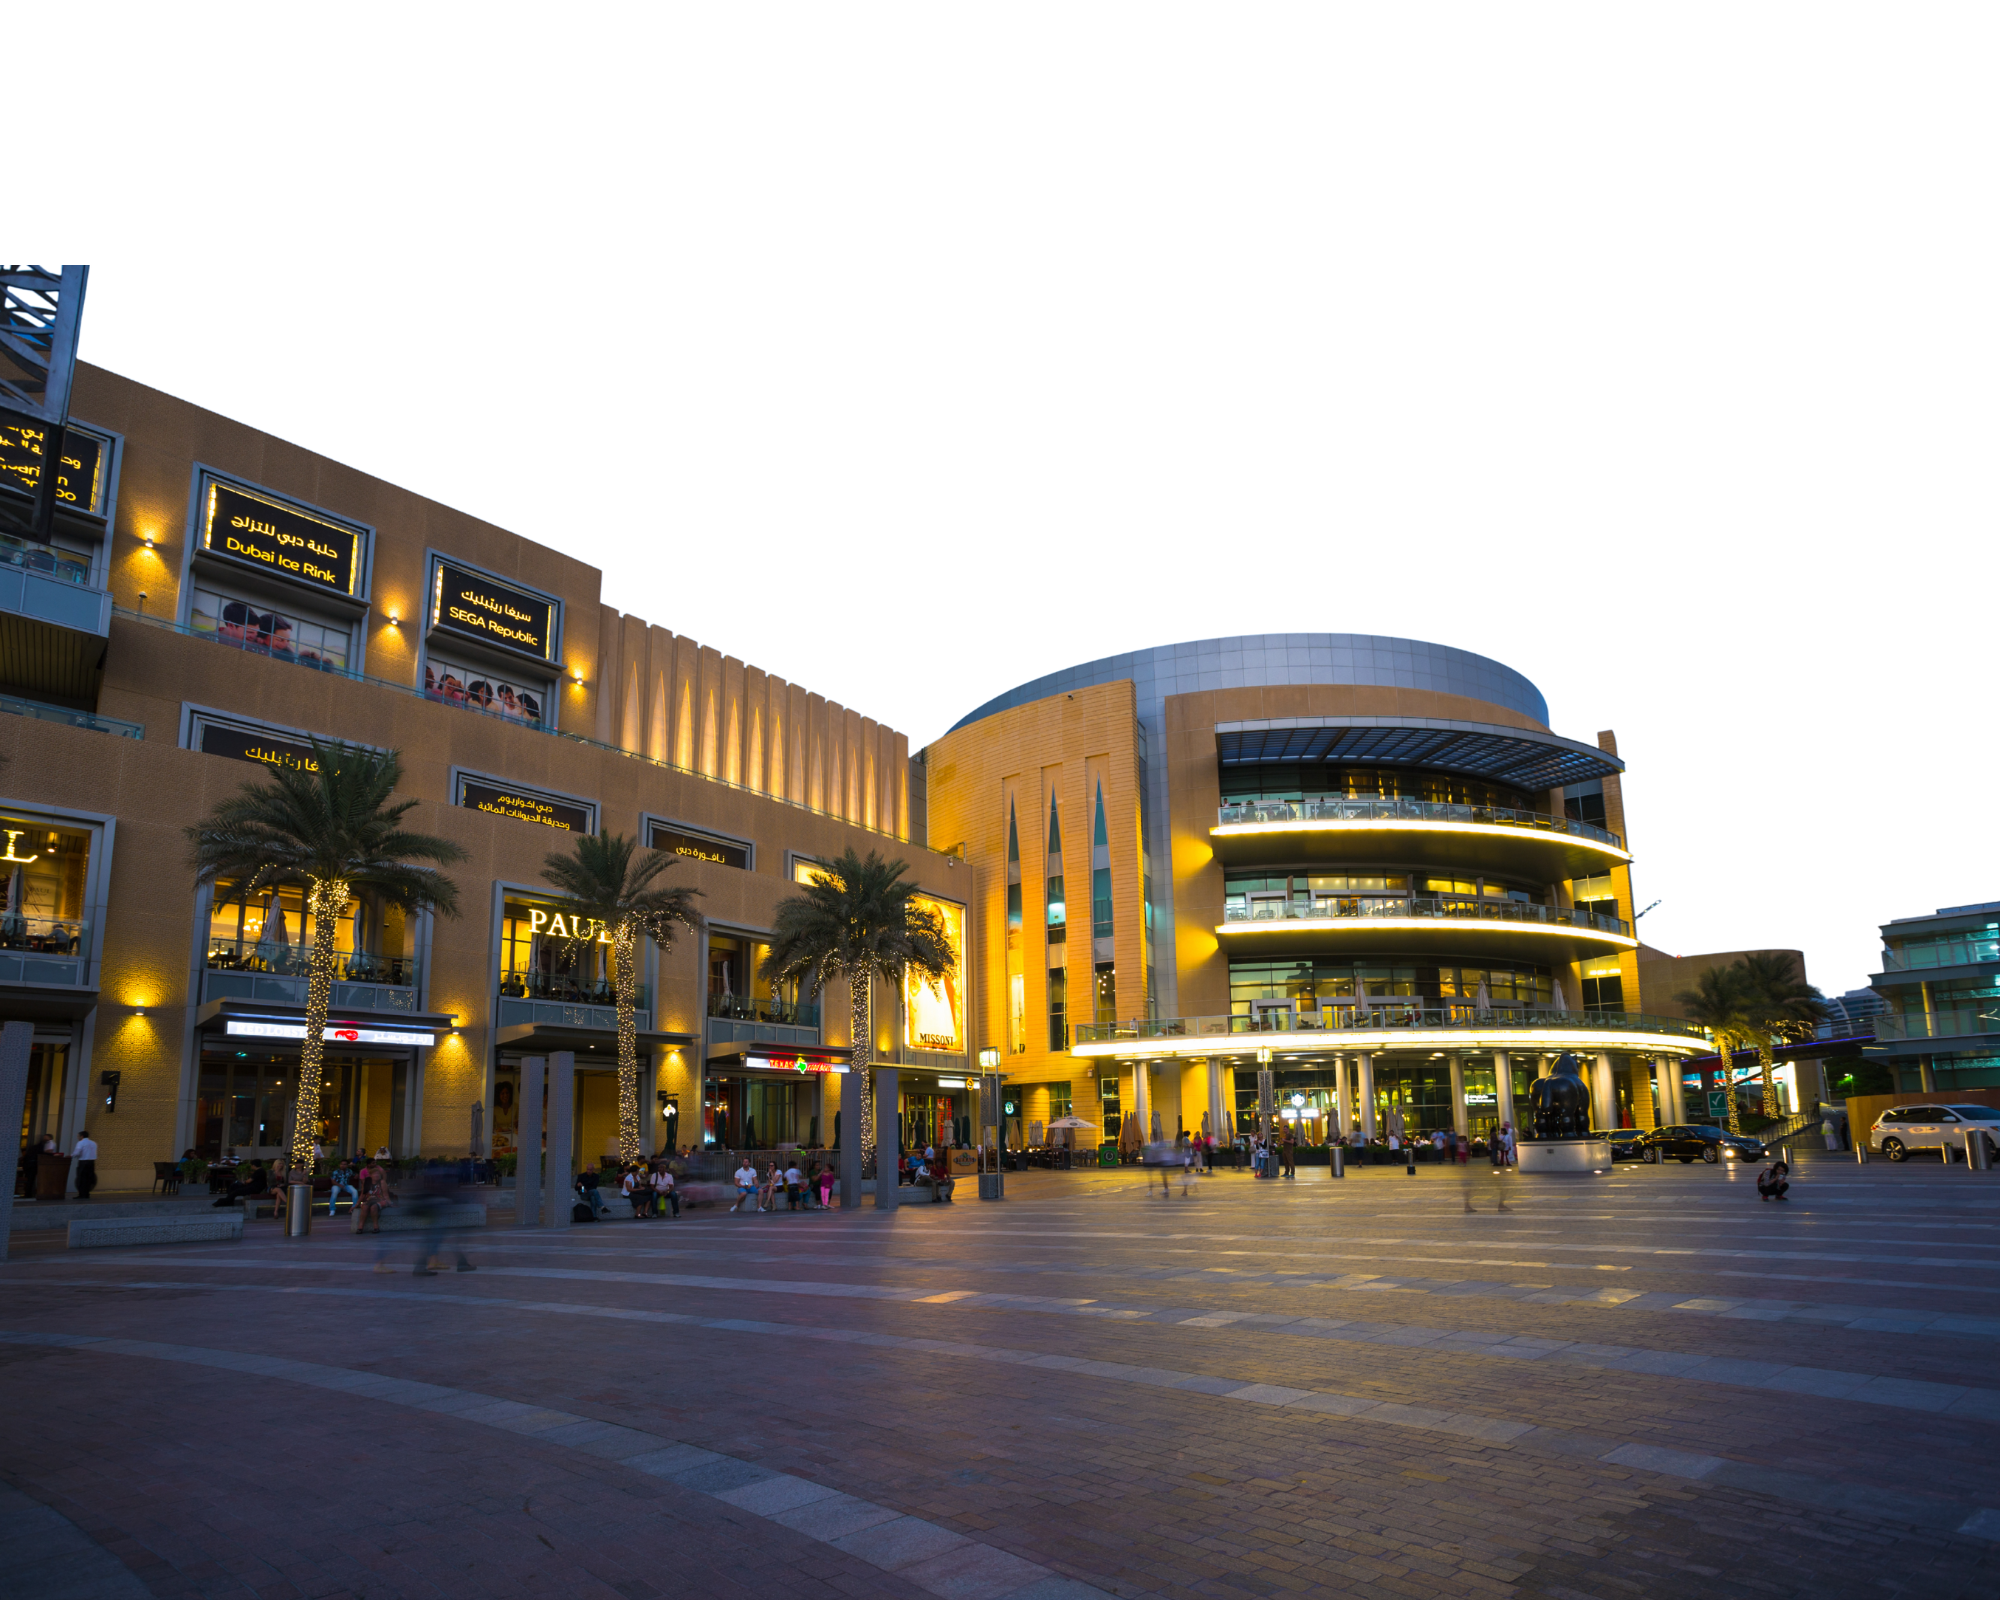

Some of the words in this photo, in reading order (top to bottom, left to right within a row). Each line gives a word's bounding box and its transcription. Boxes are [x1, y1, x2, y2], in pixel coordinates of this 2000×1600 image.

[230, 516, 276, 536] للتزلج
[277, 533, 305, 547] دبي
[307, 540, 338, 559] حلبة
[226, 536, 276, 563] Dubai
[278, 554, 300, 571] Ice
[303, 562, 336, 583] Rink
[504, 604, 532, 623] سيغا
[449, 606, 487, 629] SEGA
[488, 620, 539, 646] Republic
[505, 809, 541, 823] الحيوانات
[535, 804, 553, 813] دبي
[542, 816, 570, 831] وحديقة
[236, 1023, 264, 1036] RED
[919, 1032, 954, 1047] MISSONI
[769, 1059, 795, 1070] TEXAS
